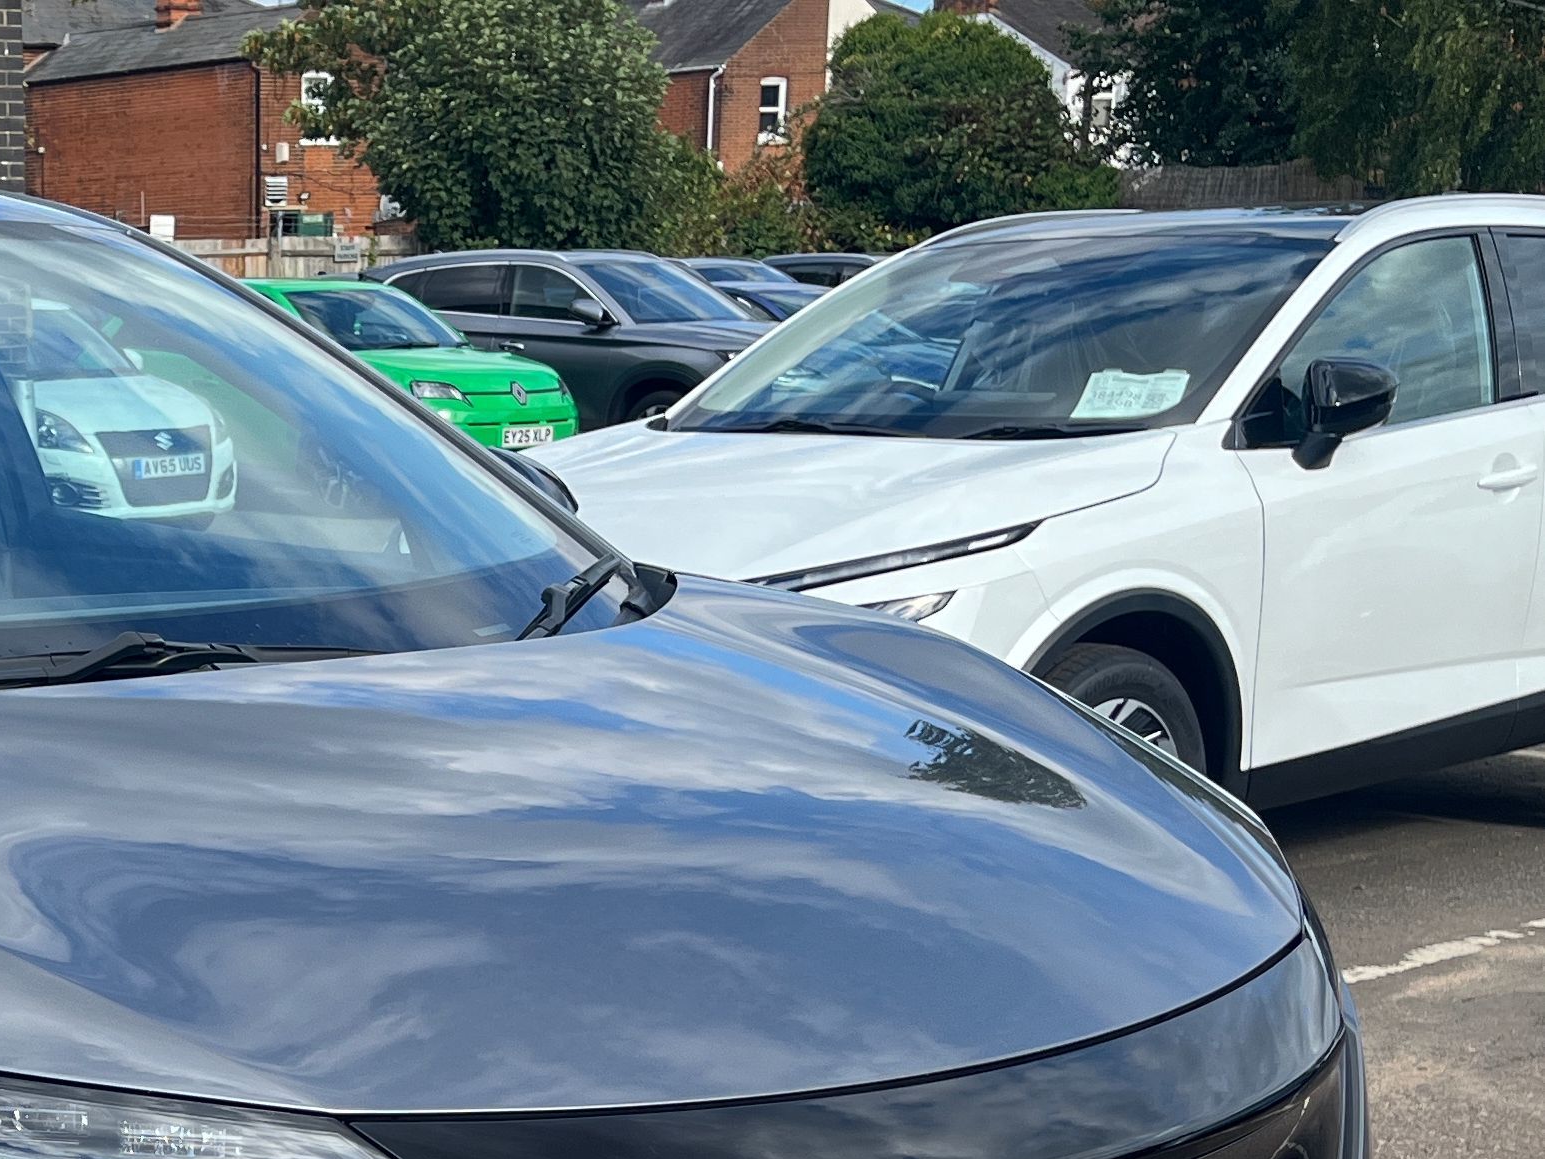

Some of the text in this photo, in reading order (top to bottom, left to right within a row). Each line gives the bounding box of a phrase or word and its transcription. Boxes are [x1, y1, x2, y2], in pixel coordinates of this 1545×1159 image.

[504, 428, 551, 444] EY25 XLP
[144, 456, 202, 475] AV65 UUS
